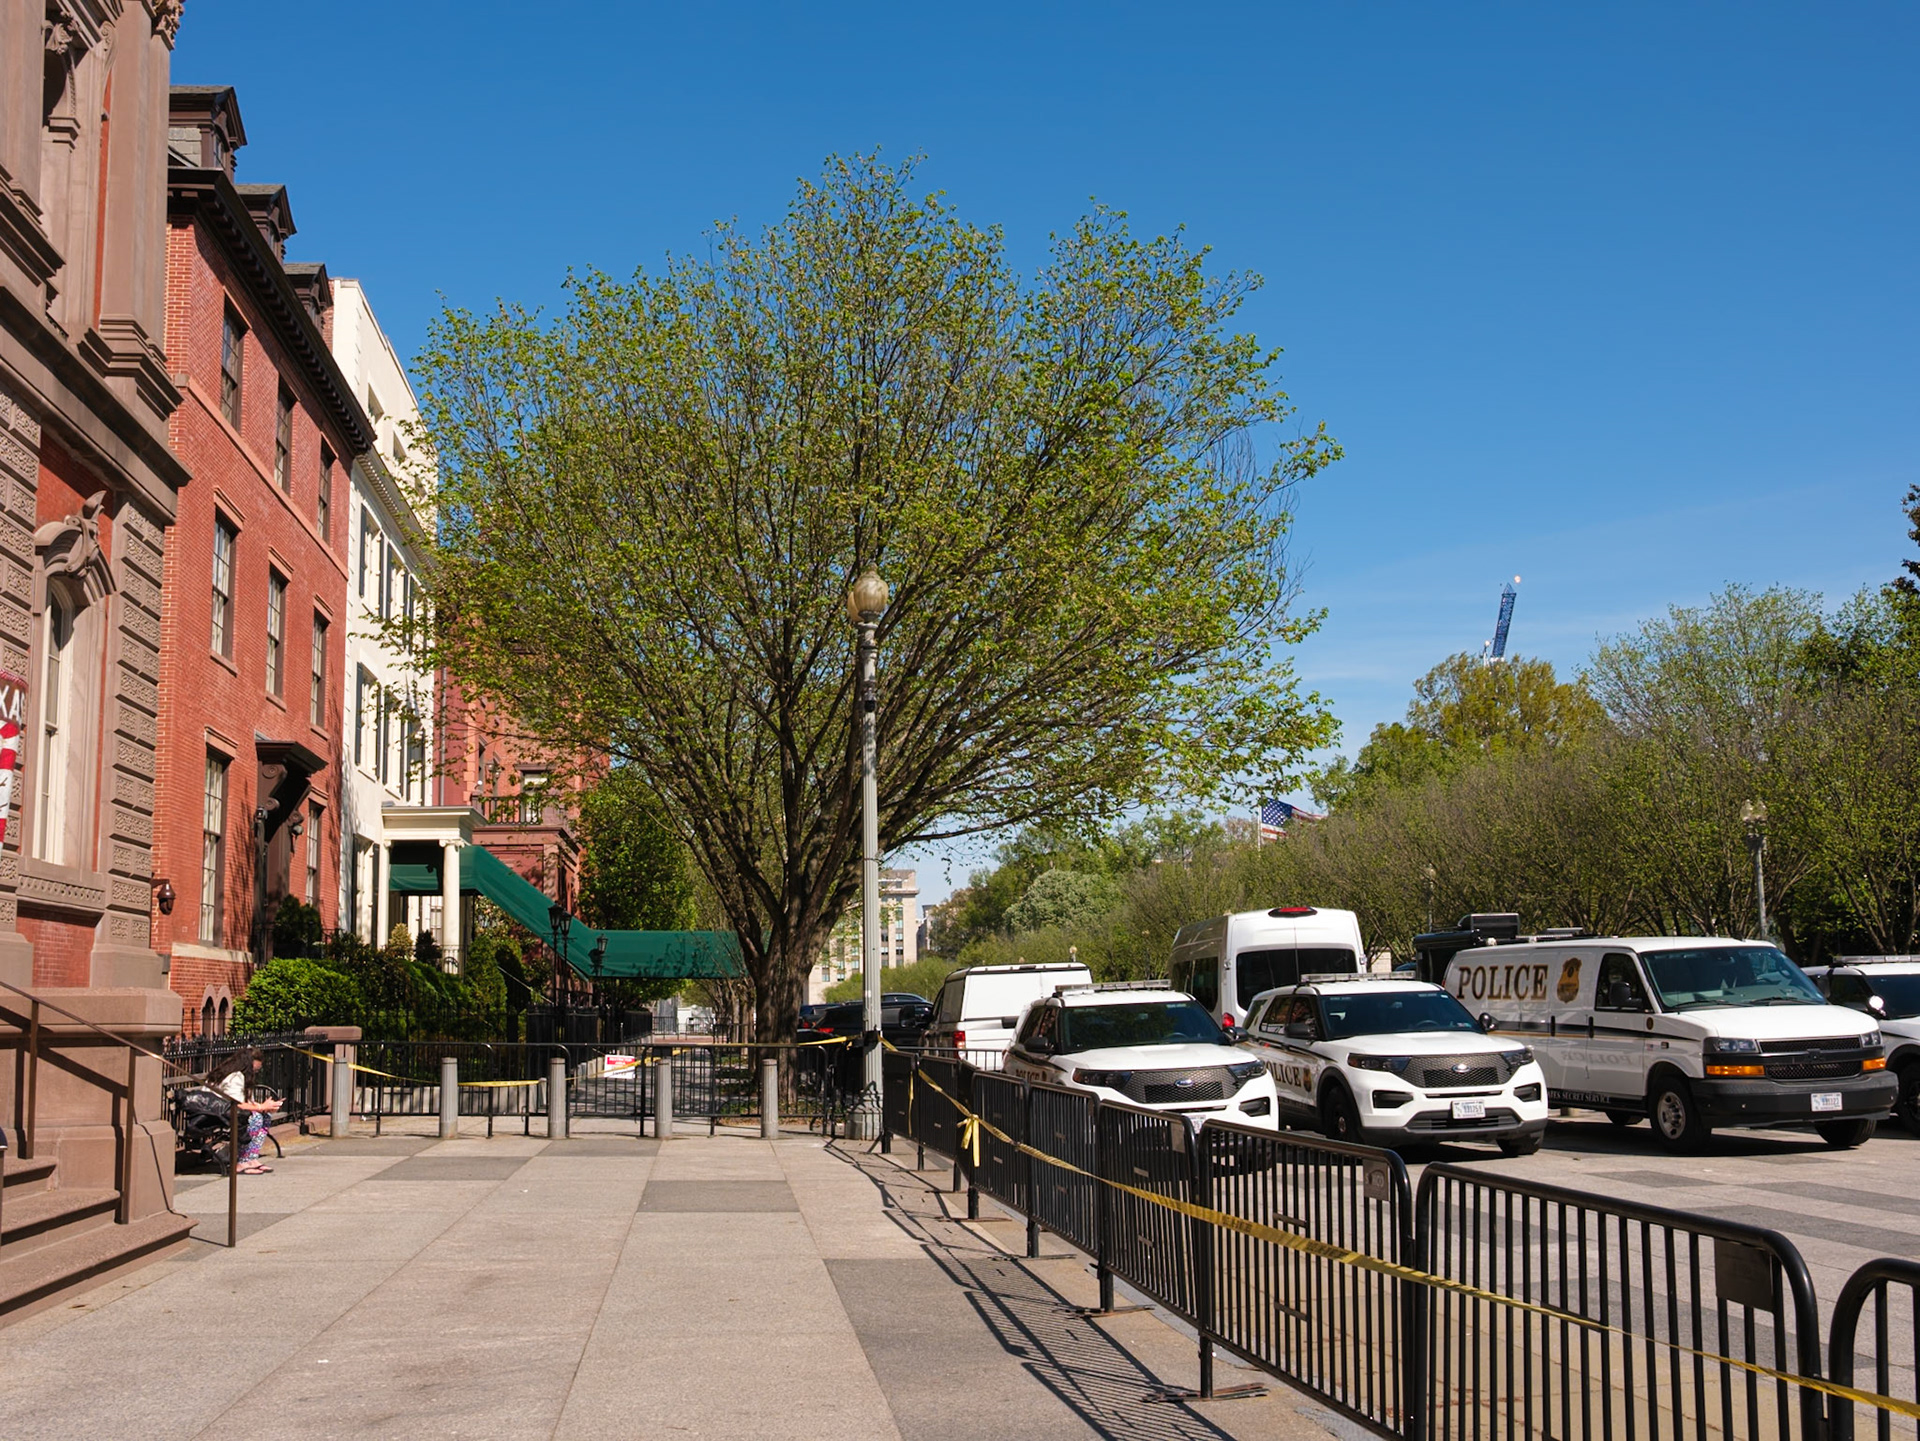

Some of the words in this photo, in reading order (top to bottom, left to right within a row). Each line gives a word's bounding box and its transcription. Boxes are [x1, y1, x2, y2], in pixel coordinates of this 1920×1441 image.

[1457, 964, 1549, 1000] POLICE
[1266, 1060, 1301, 1088] OLICE
[1562, 1091, 1585, 1101] SECRET
[1585, 1093, 1611, 1104] SERVICE
